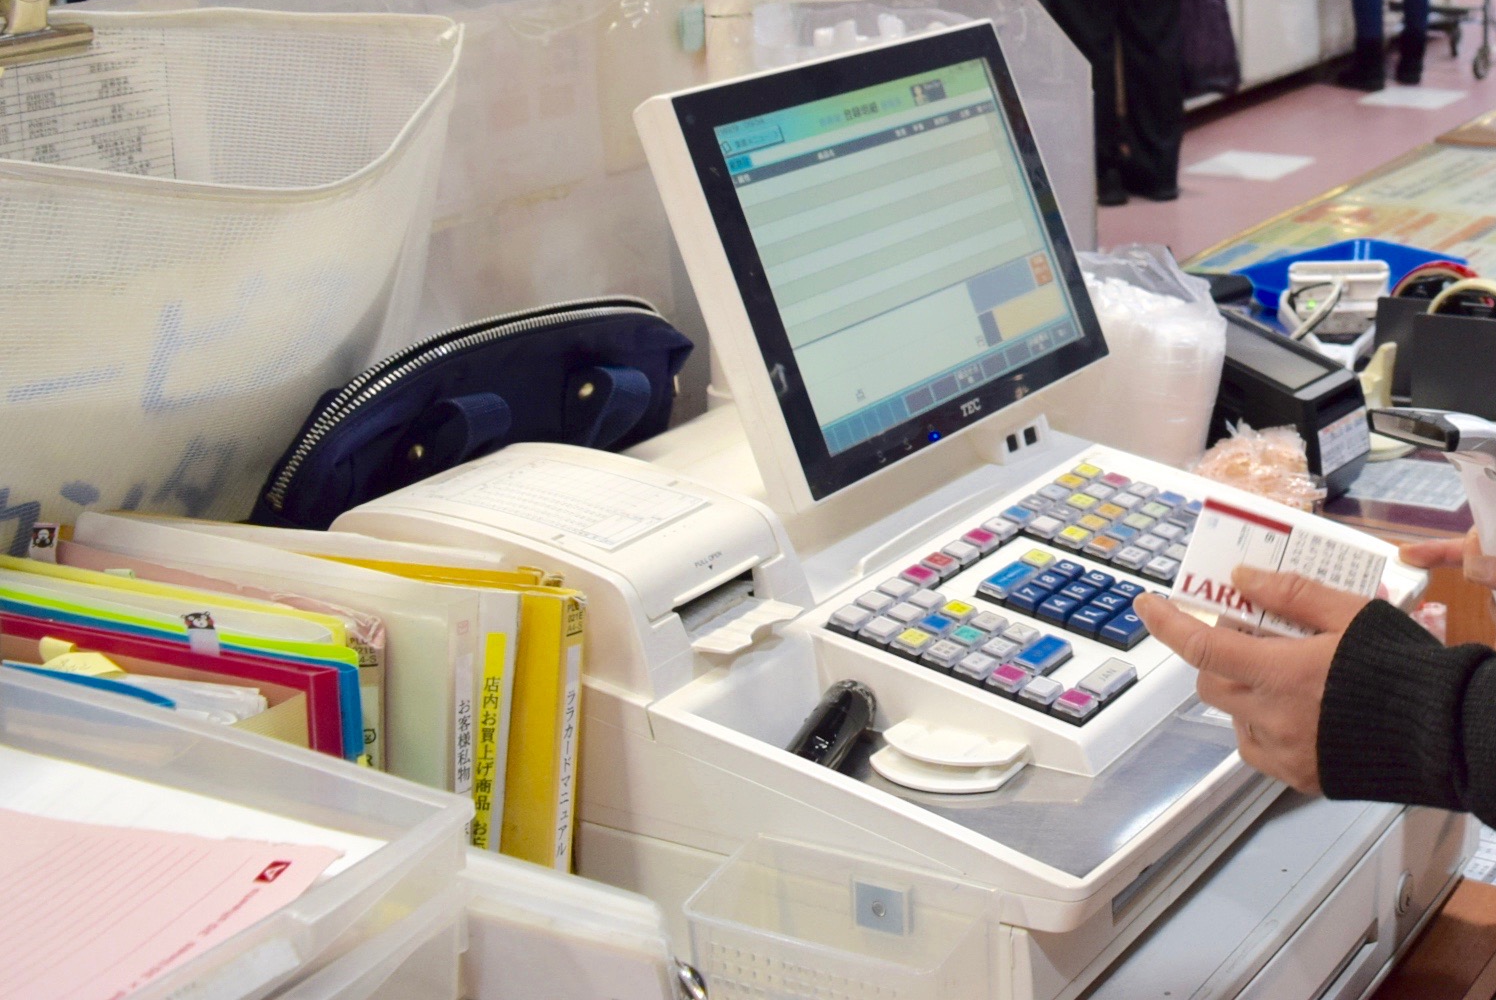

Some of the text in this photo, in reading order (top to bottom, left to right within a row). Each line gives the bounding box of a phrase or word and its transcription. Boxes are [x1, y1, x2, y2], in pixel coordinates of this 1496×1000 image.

[960, 397, 982, 418] TEC
[1060, 562, 1075, 570] 9
[1041, 575, 1056, 583] 8
[1091, 573, 1105, 581] 6
[1022, 587, 1036, 596] 7
[1071, 585, 1087, 594] 5
[1120, 584, 1134, 592] 3
[1053, 600, 1067, 608] 4
[1102, 596, 1117, 605] 2
[1124, 614, 1139, 622] 0
[358, 655, 377, 663] 4-S
[457, 699, 471, 784] お客様私物
[475, 676, 501, 812] 店内お買上げ商品
[556, 689, 576, 857] ララカードマニュアル
